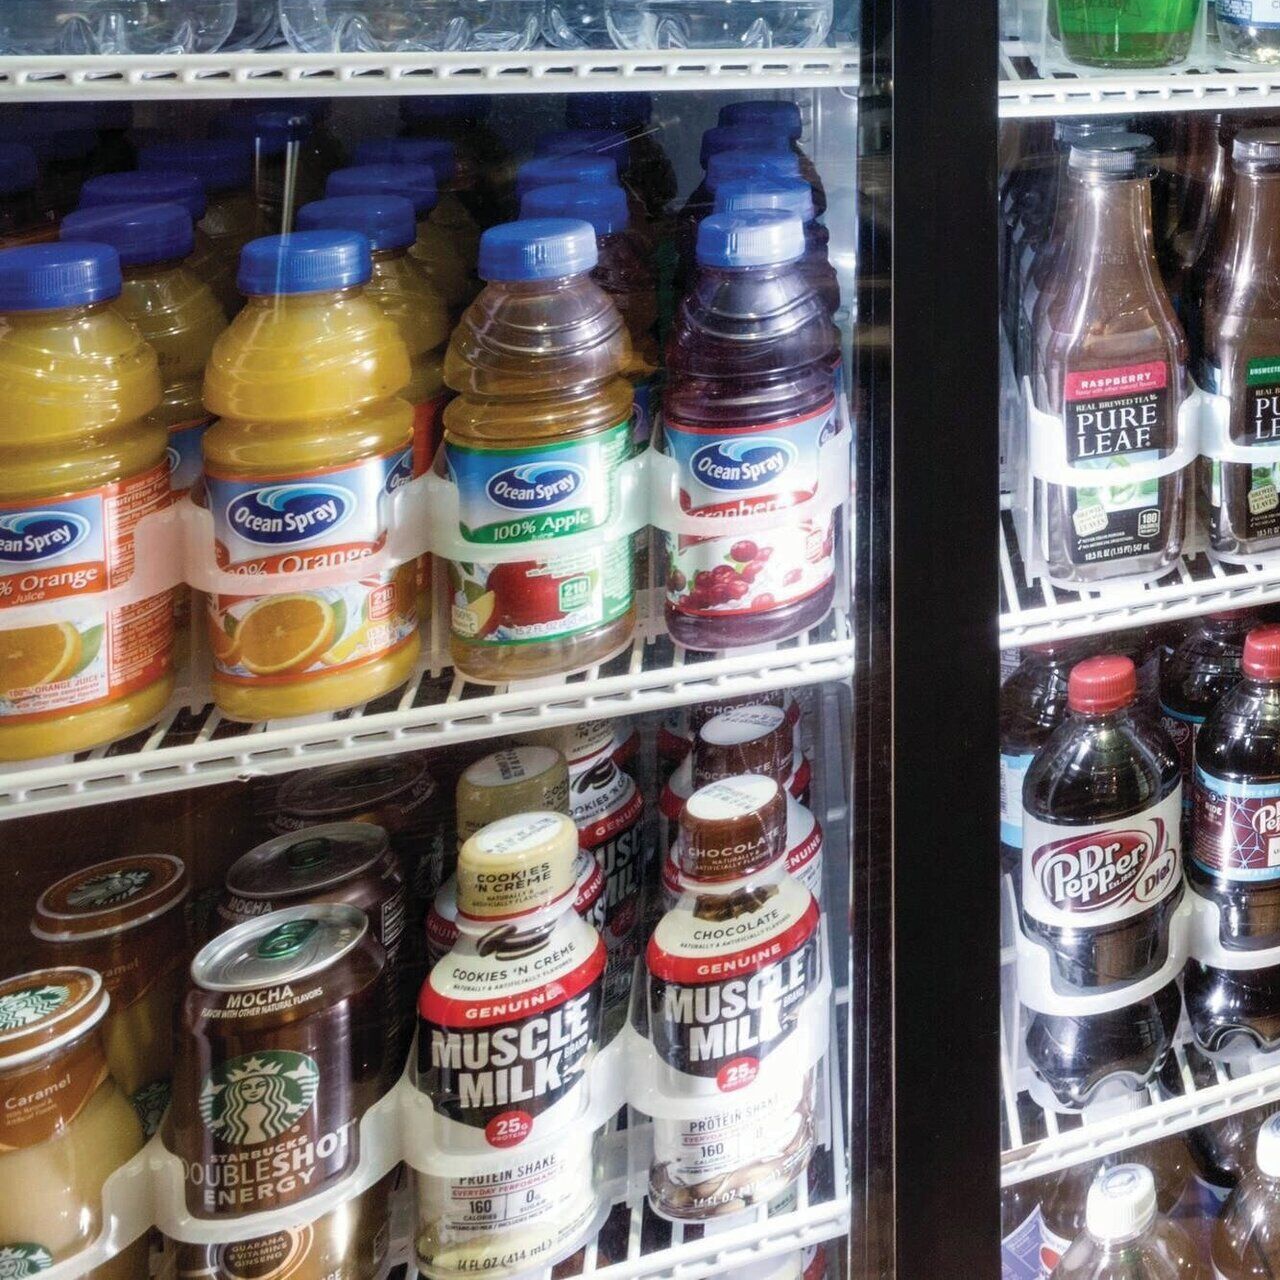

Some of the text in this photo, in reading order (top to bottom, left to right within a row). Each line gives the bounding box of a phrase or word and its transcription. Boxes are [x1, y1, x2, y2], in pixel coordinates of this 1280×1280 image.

[1081, 371, 1152, 390] RASPBERRY
[1076, 403, 1097, 412] REAL
[1099, 398, 1133, 410] BREWED
[1076, 404, 1158, 436] PURE
[1076, 430, 1152, 460] LEAF
[699, 449, 785, 481] Ocean Spray
[494, 473, 576, 501] Ocean Spray
[234, 498, 338, 533] Ocean Spray
[493, 510, 589, 542] 100% Apple
[1141, 512, 1159, 525] 180
[21, 567, 98, 593] Orange
[687, 825, 781, 859] CHOCOLATE
[1079, 840, 1120, 872] Dr
[476, 861, 552, 883] COOKIES
[1050, 842, 1147, 904] Pepper
[693, 908, 780, 942] CHOCOLATE
[452, 967, 508, 982] COOKIES
[697, 942, 782, 977] GENUINE
[227, 984, 294, 1009] MOCHA
[662, 947, 806, 1026] MUSCLE
[464, 987, 558, 1020] GENUINE
[431, 992, 591, 1070] MUSCLE
[689, 991, 782, 1062] MILK
[4, 1072, 72, 1111] Caramel
[459, 1047, 566, 1109] MILK
[210, 1133, 309, 1164] STARBUCKS
[700, 1143, 725, 1158] 160
[516, 1152, 557, 1178] SHAKE
[203, 1168, 316, 1207] ENERGY
[468, 1199, 493, 1216] 160
